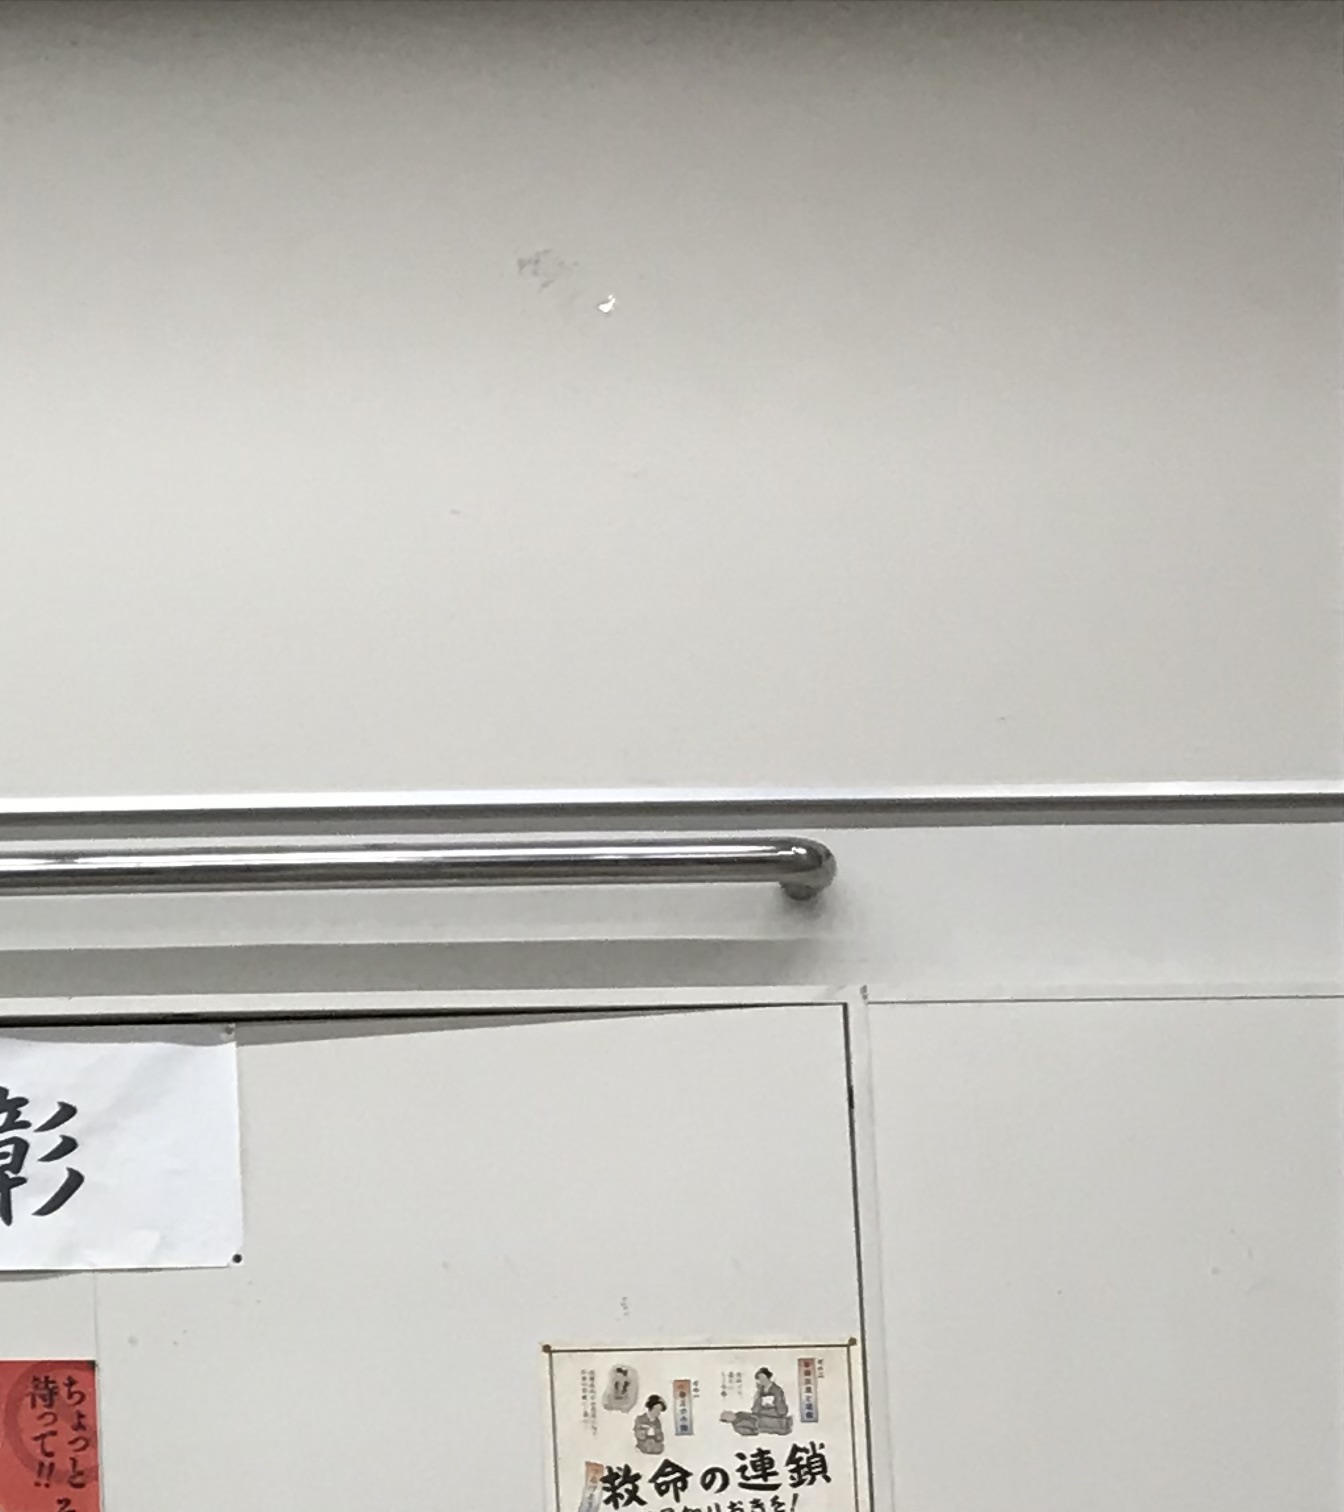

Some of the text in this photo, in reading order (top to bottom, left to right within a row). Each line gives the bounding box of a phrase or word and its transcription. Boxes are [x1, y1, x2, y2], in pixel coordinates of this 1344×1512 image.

[63, 1375, 90, 1489] ちょっと
[601, 1441, 832, 1510] 救命の連鎖
